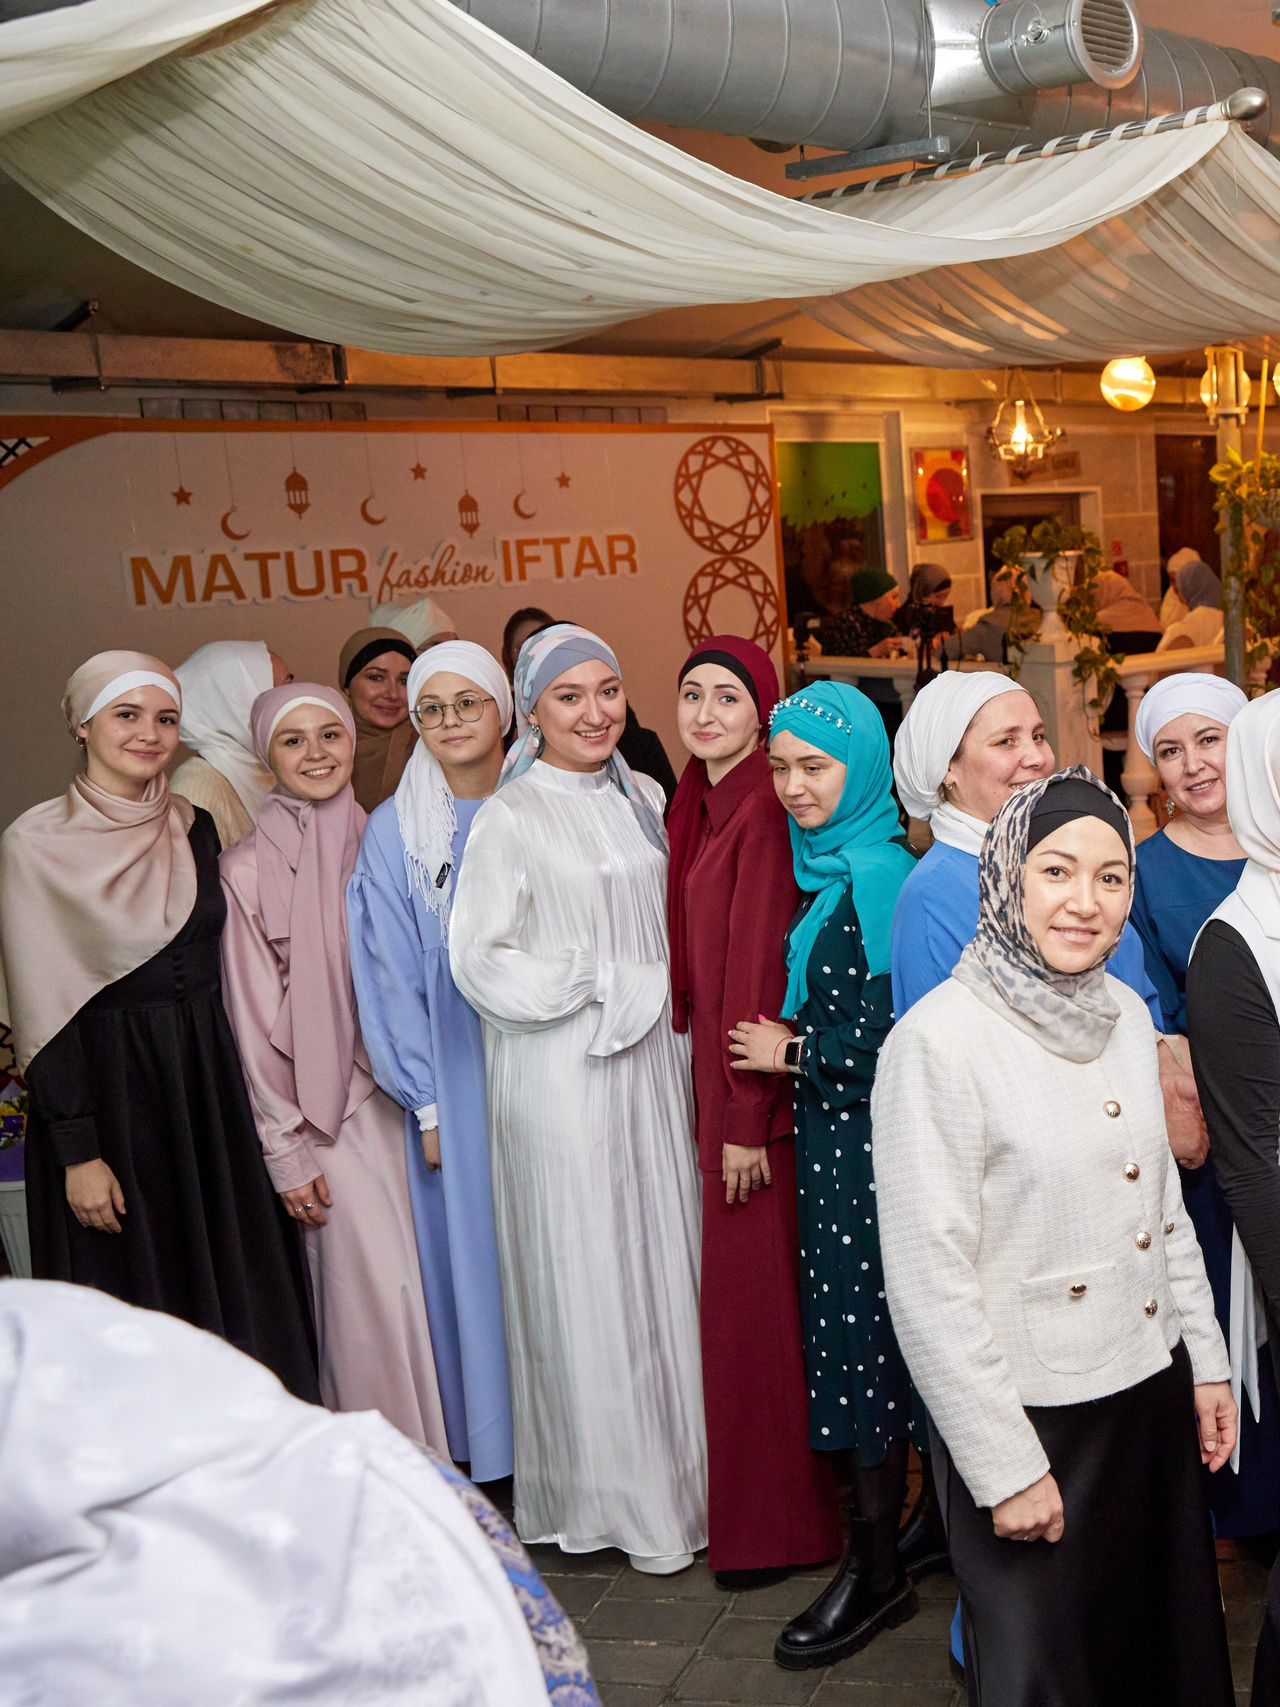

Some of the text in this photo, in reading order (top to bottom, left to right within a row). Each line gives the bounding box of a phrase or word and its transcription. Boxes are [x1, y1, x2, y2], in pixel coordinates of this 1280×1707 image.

[130, 534, 638, 606] MATUR fashion IFTAR
